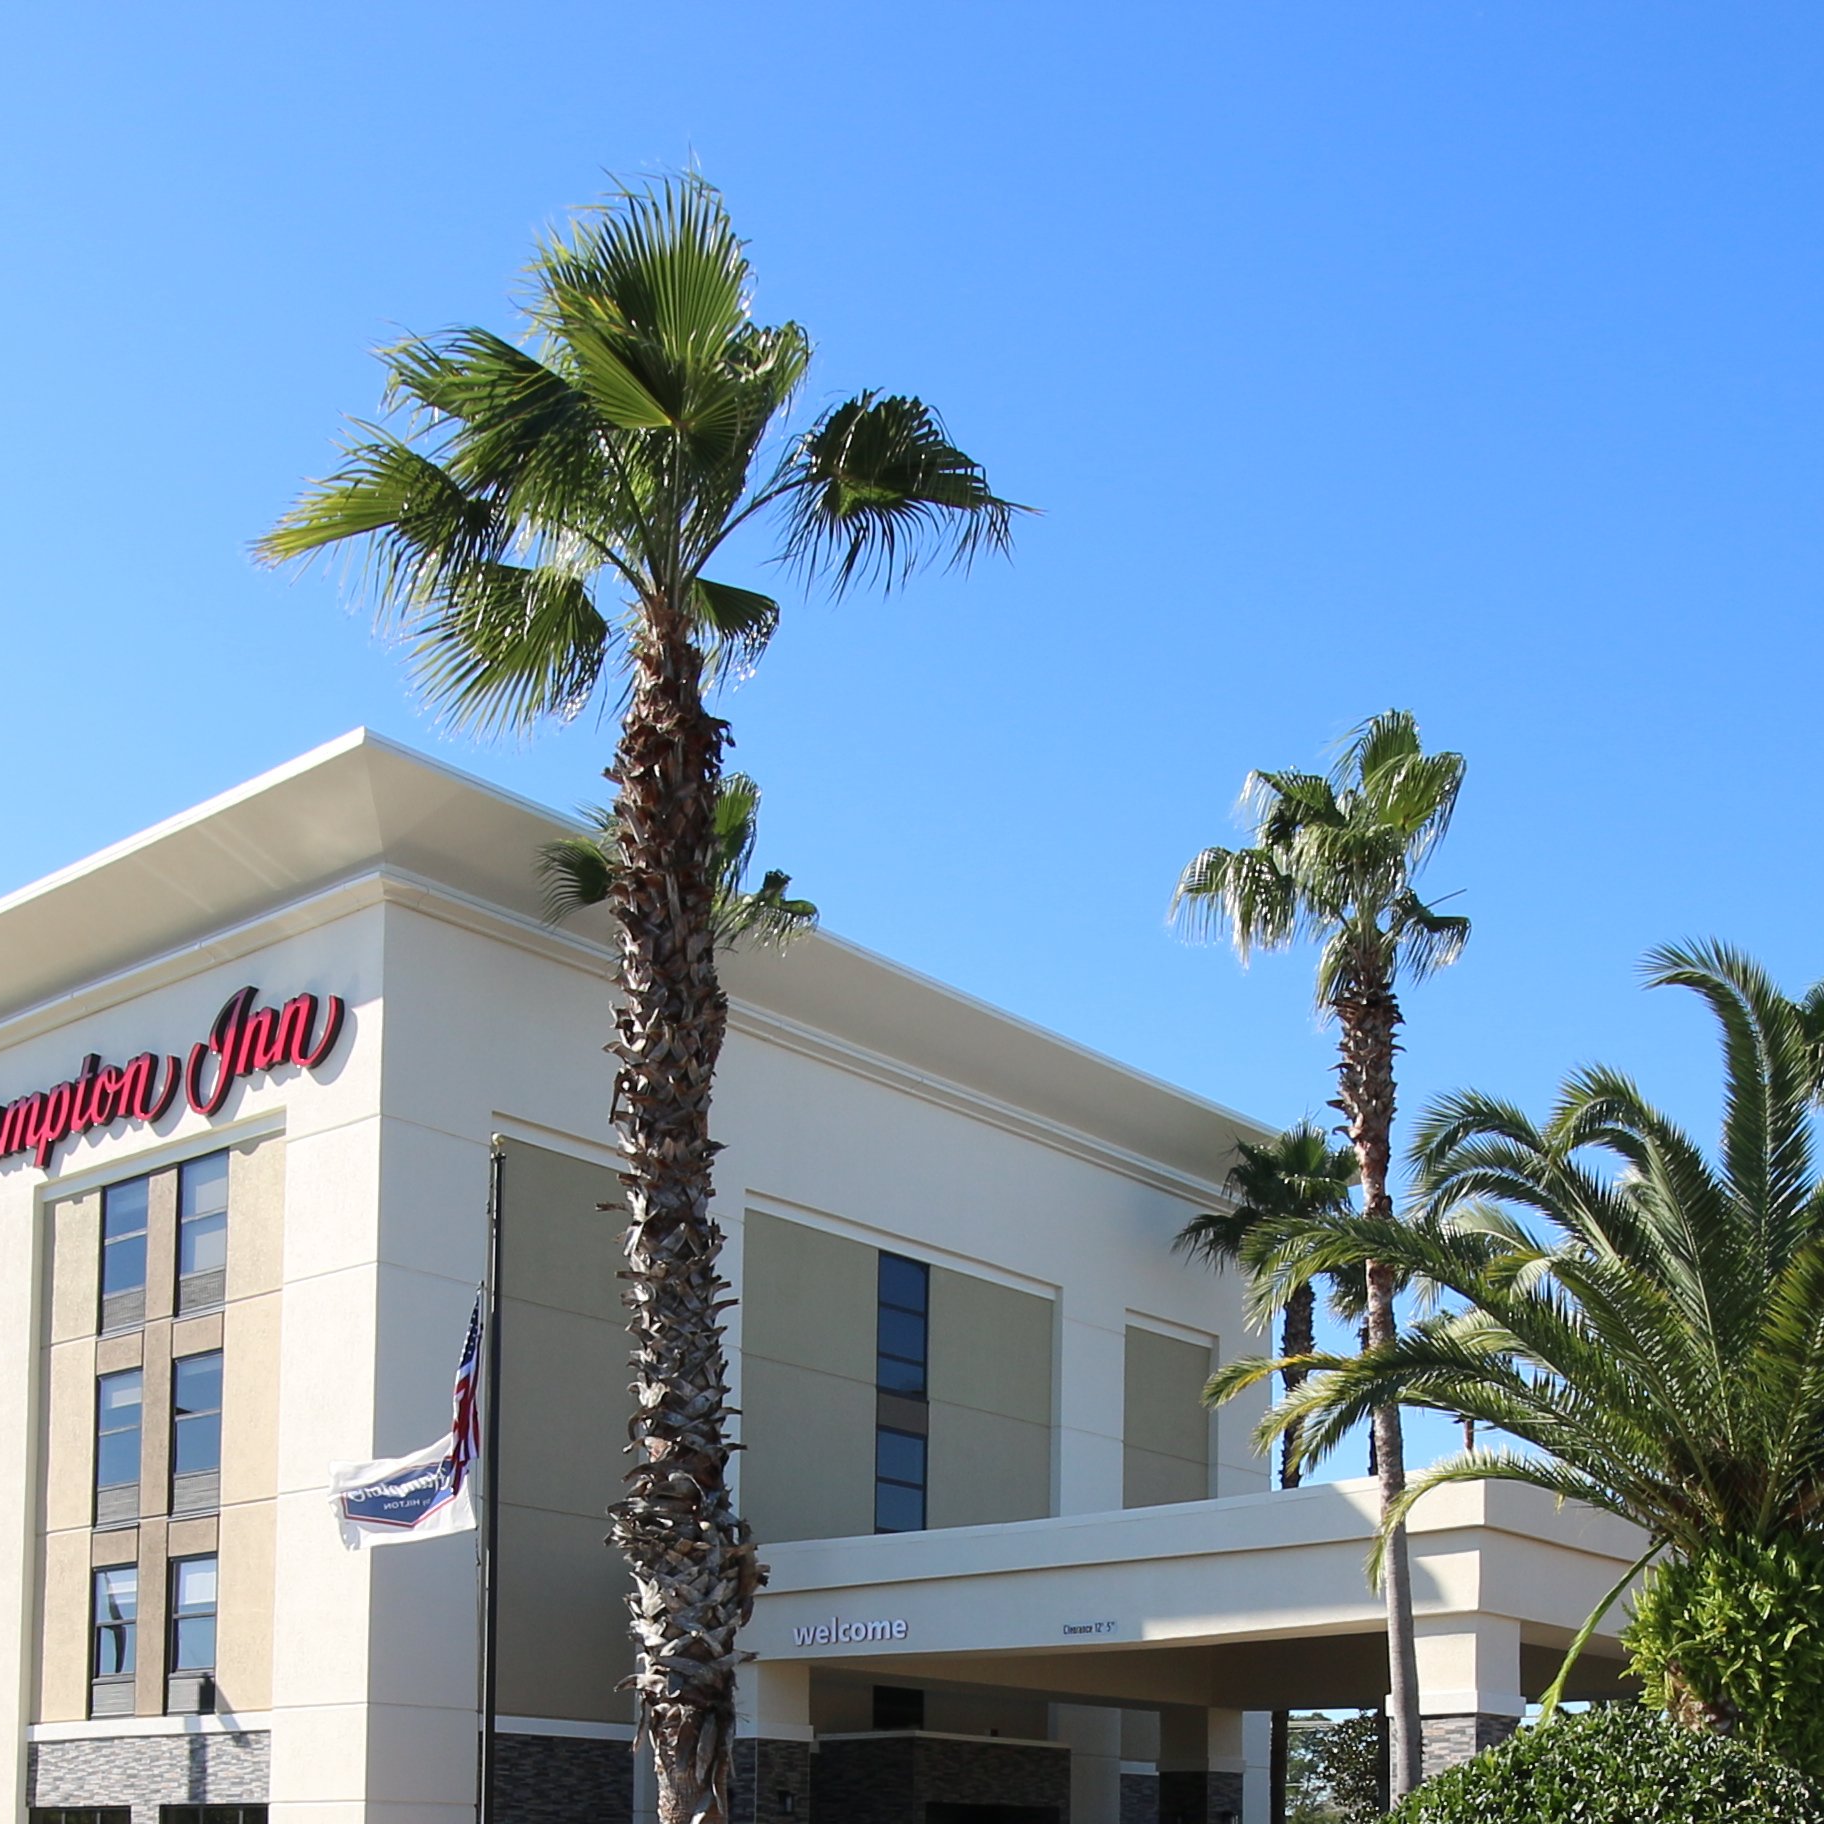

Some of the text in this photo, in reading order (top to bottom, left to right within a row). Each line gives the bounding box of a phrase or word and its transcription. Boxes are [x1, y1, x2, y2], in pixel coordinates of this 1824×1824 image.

[186, 986, 345, 1118] Inn
[792, 1616, 909, 1647] welcome
[1063, 1624, 1093, 1635] Clearance
